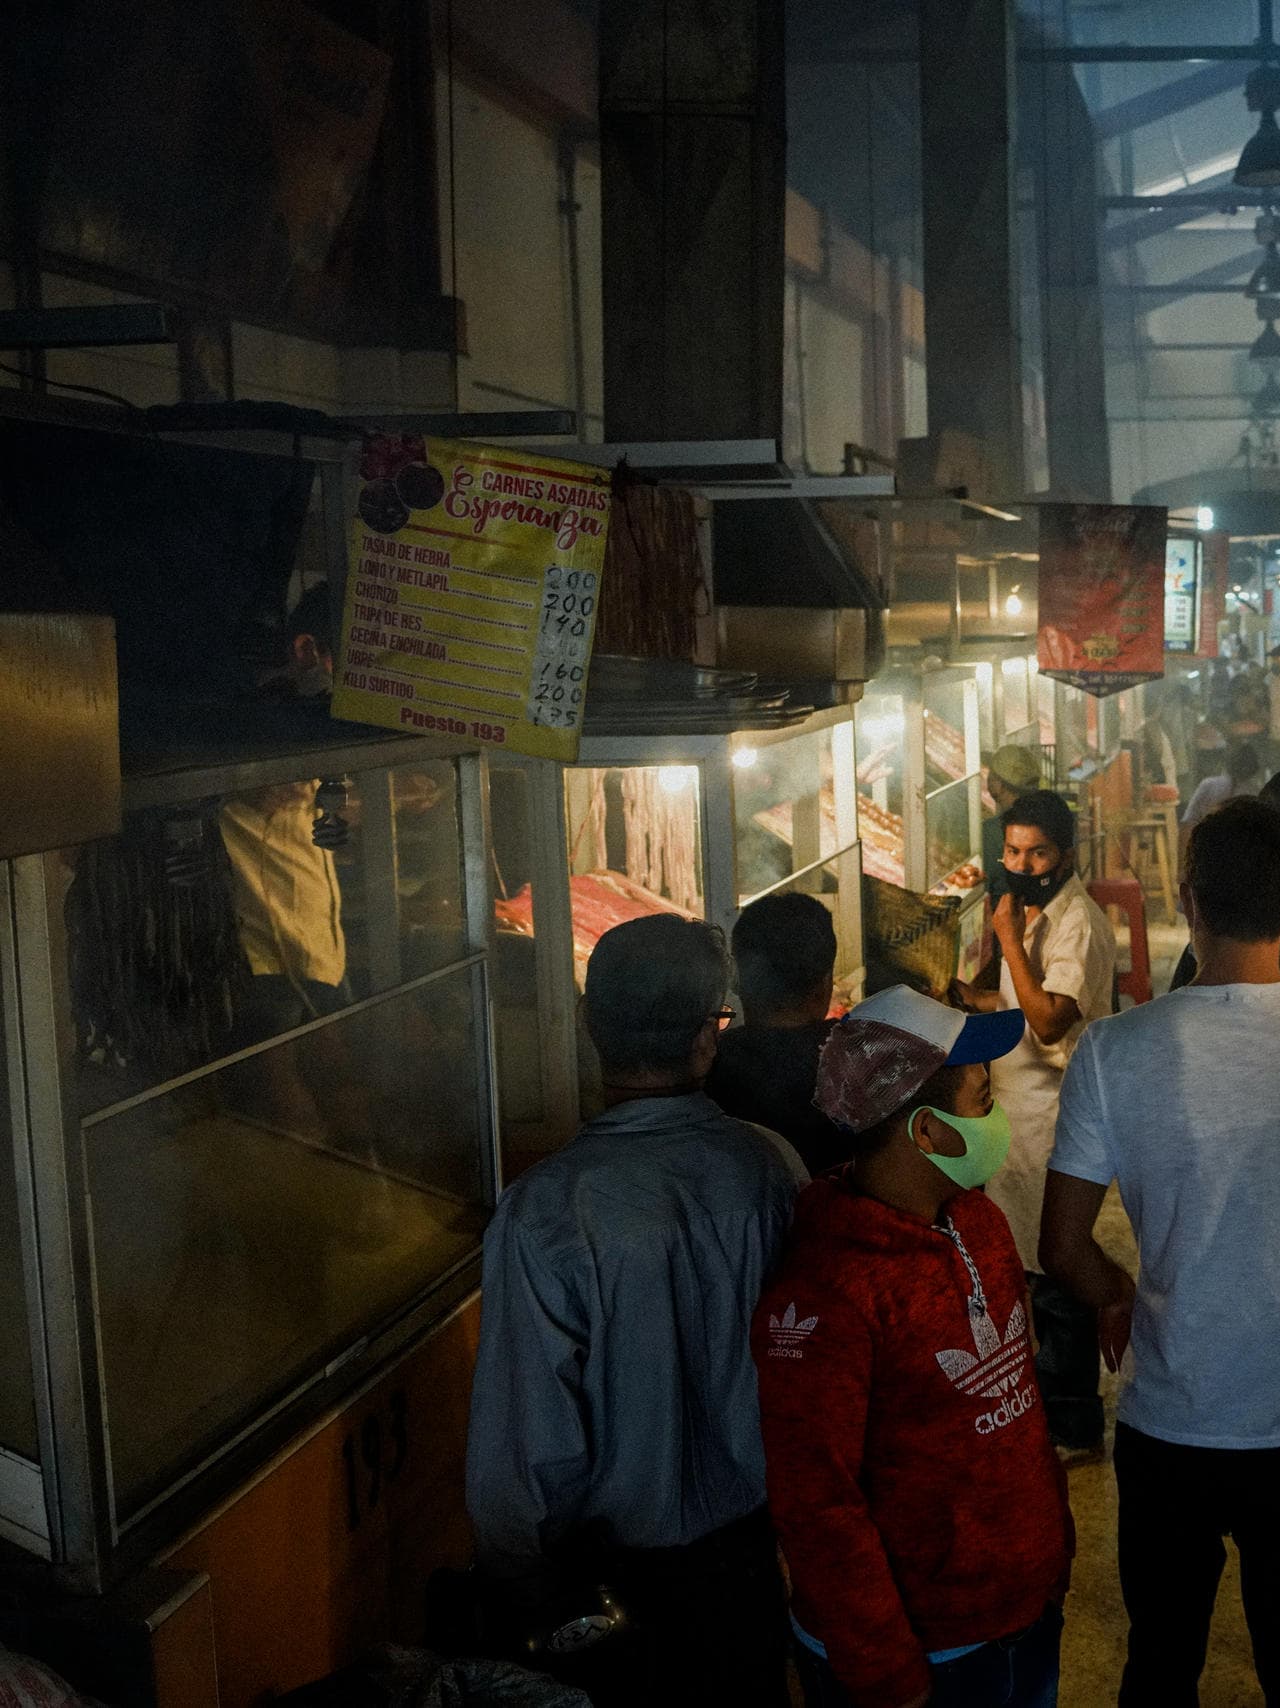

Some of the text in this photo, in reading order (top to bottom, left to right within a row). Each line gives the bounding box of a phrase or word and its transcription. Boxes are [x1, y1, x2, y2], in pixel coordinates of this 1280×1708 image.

[483, 471, 608, 511] CARNES ASADAS
[445, 466, 602, 550] Esperanza
[398, 543, 412, 561] DE
[415, 546, 450, 569] HEBRA
[355, 581, 399, 605] CHORIZO
[544, 593, 594, 616] 200
[384, 610, 398, 626] DE
[401, 615, 422, 631] RES
[389, 633, 447, 661] ENCHILADA
[540, 662, 584, 682] 160
[348, 650, 582, 704] UBRE 200
[369, 676, 415, 700] SURTIDO
[400, 708, 506, 744] Puesto 193
